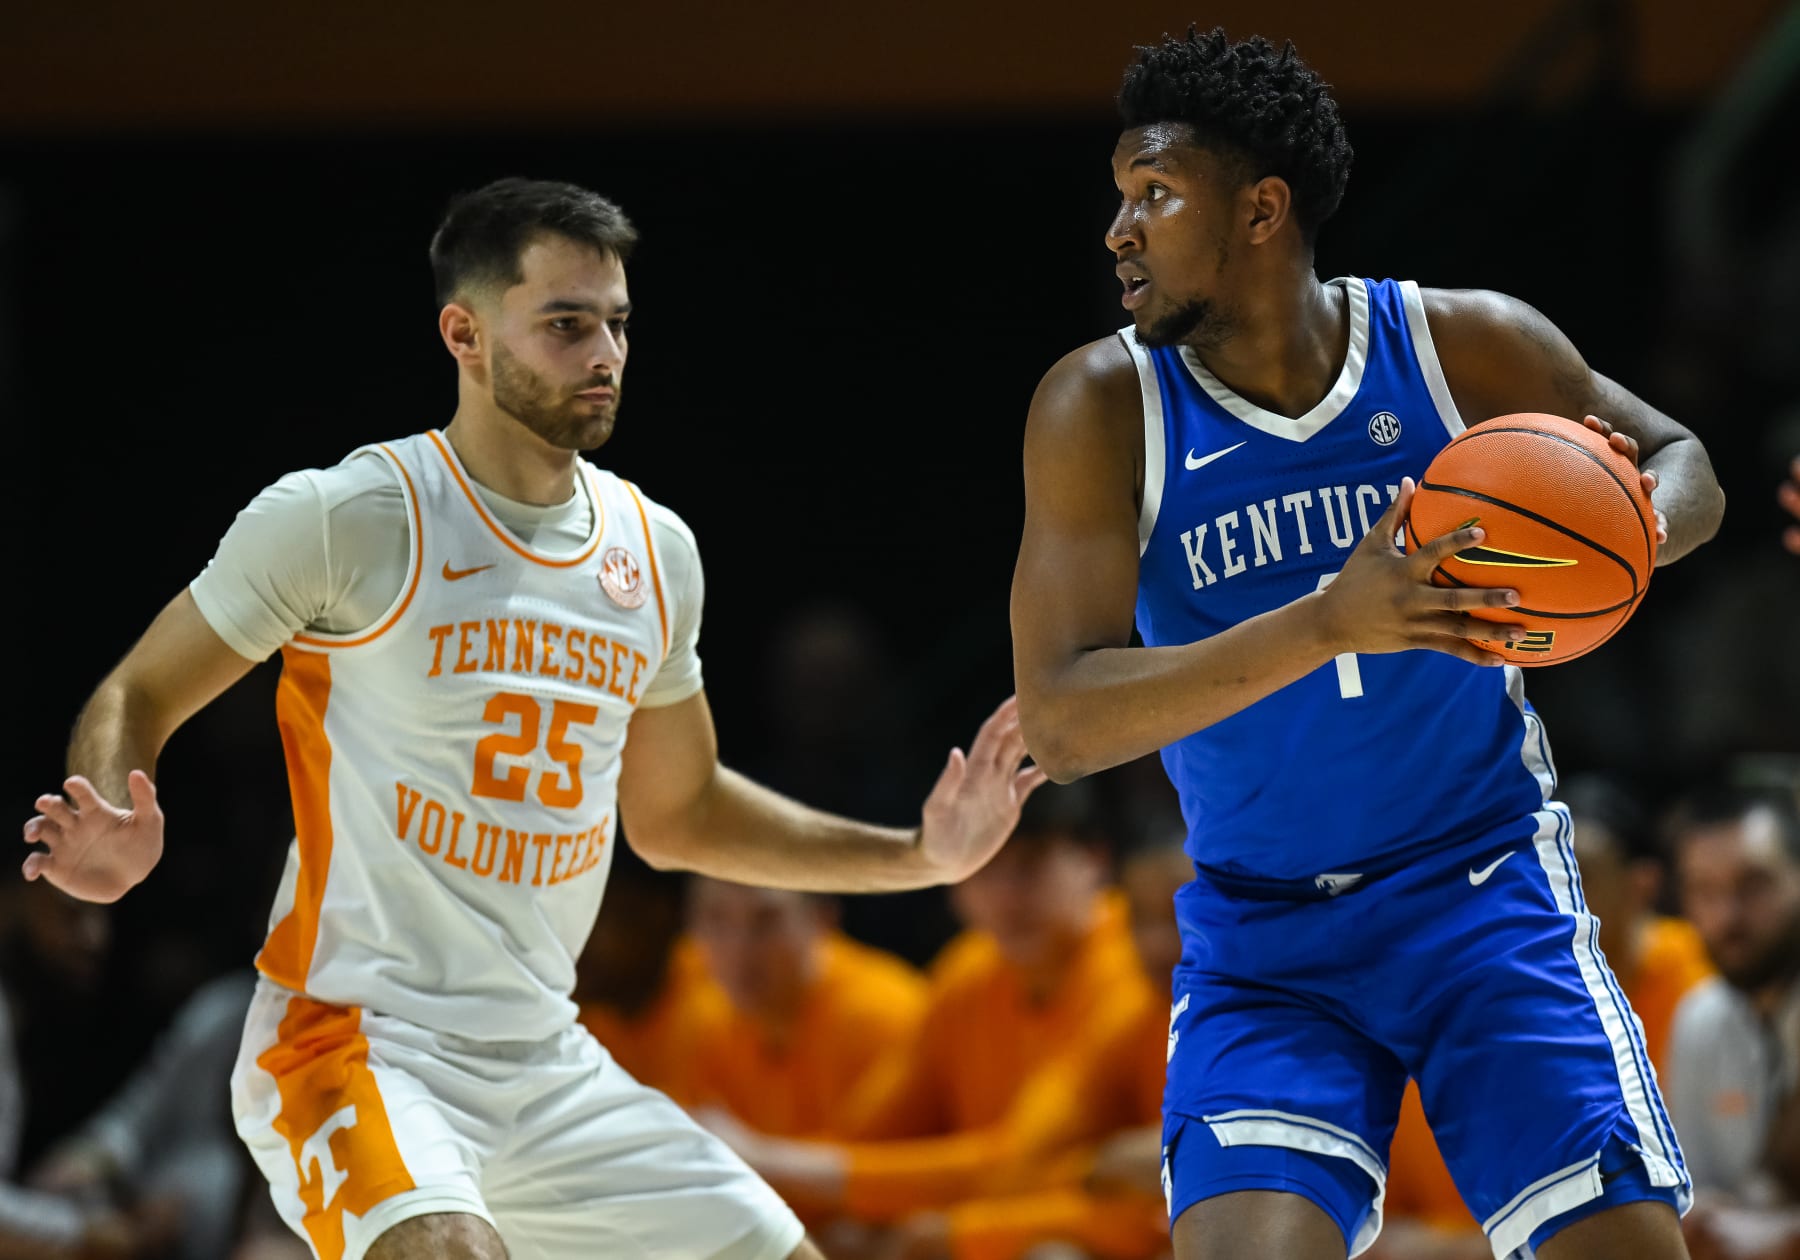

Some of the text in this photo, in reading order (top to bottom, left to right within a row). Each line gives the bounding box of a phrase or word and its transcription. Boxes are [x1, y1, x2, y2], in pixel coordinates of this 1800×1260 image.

[1371, 414, 1399, 443] SEC
[604, 549, 640, 592] SEC
[1180, 484, 1405, 590] KENTUC
[427, 618, 648, 706] TENNESSEE
[470, 691, 599, 809] 25
